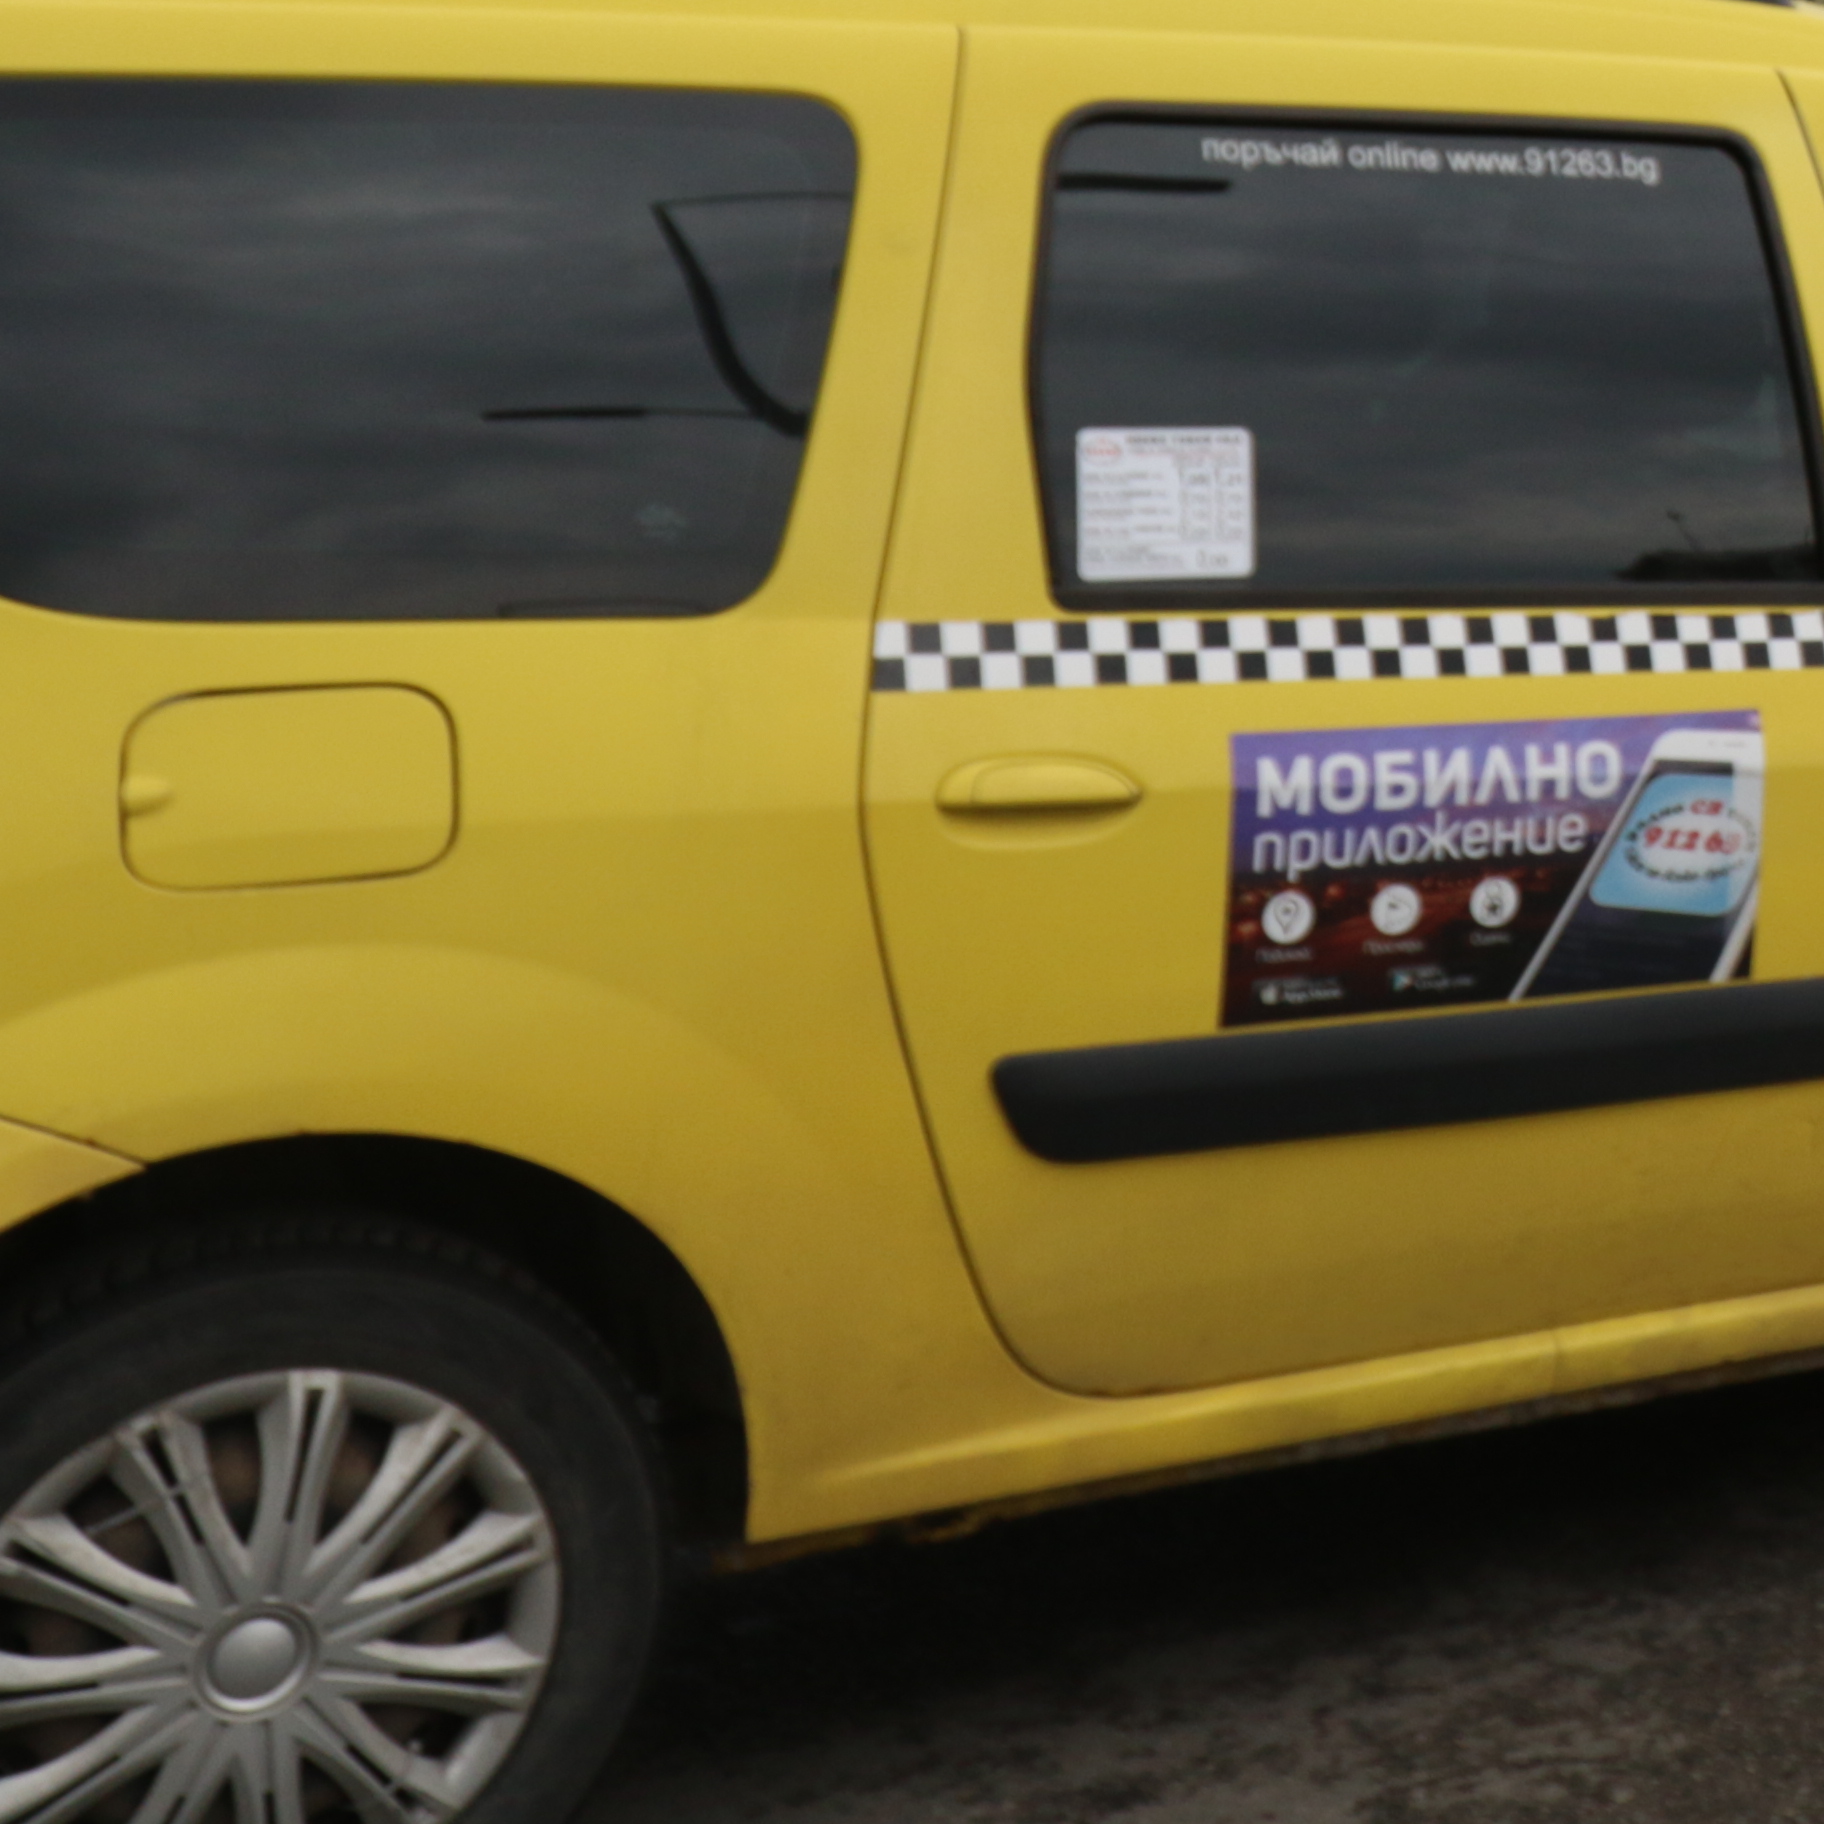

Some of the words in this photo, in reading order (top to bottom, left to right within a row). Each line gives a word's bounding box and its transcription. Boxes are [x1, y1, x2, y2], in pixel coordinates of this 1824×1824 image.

[1201, 136, 1341, 169] поръчай
[1347, 140, 1441, 171] online
[1446, 145, 1661, 186] www.91263.bg
[1254, 739, 1623, 819] МОБИЛНО
[1252, 810, 1589, 884] приложение
